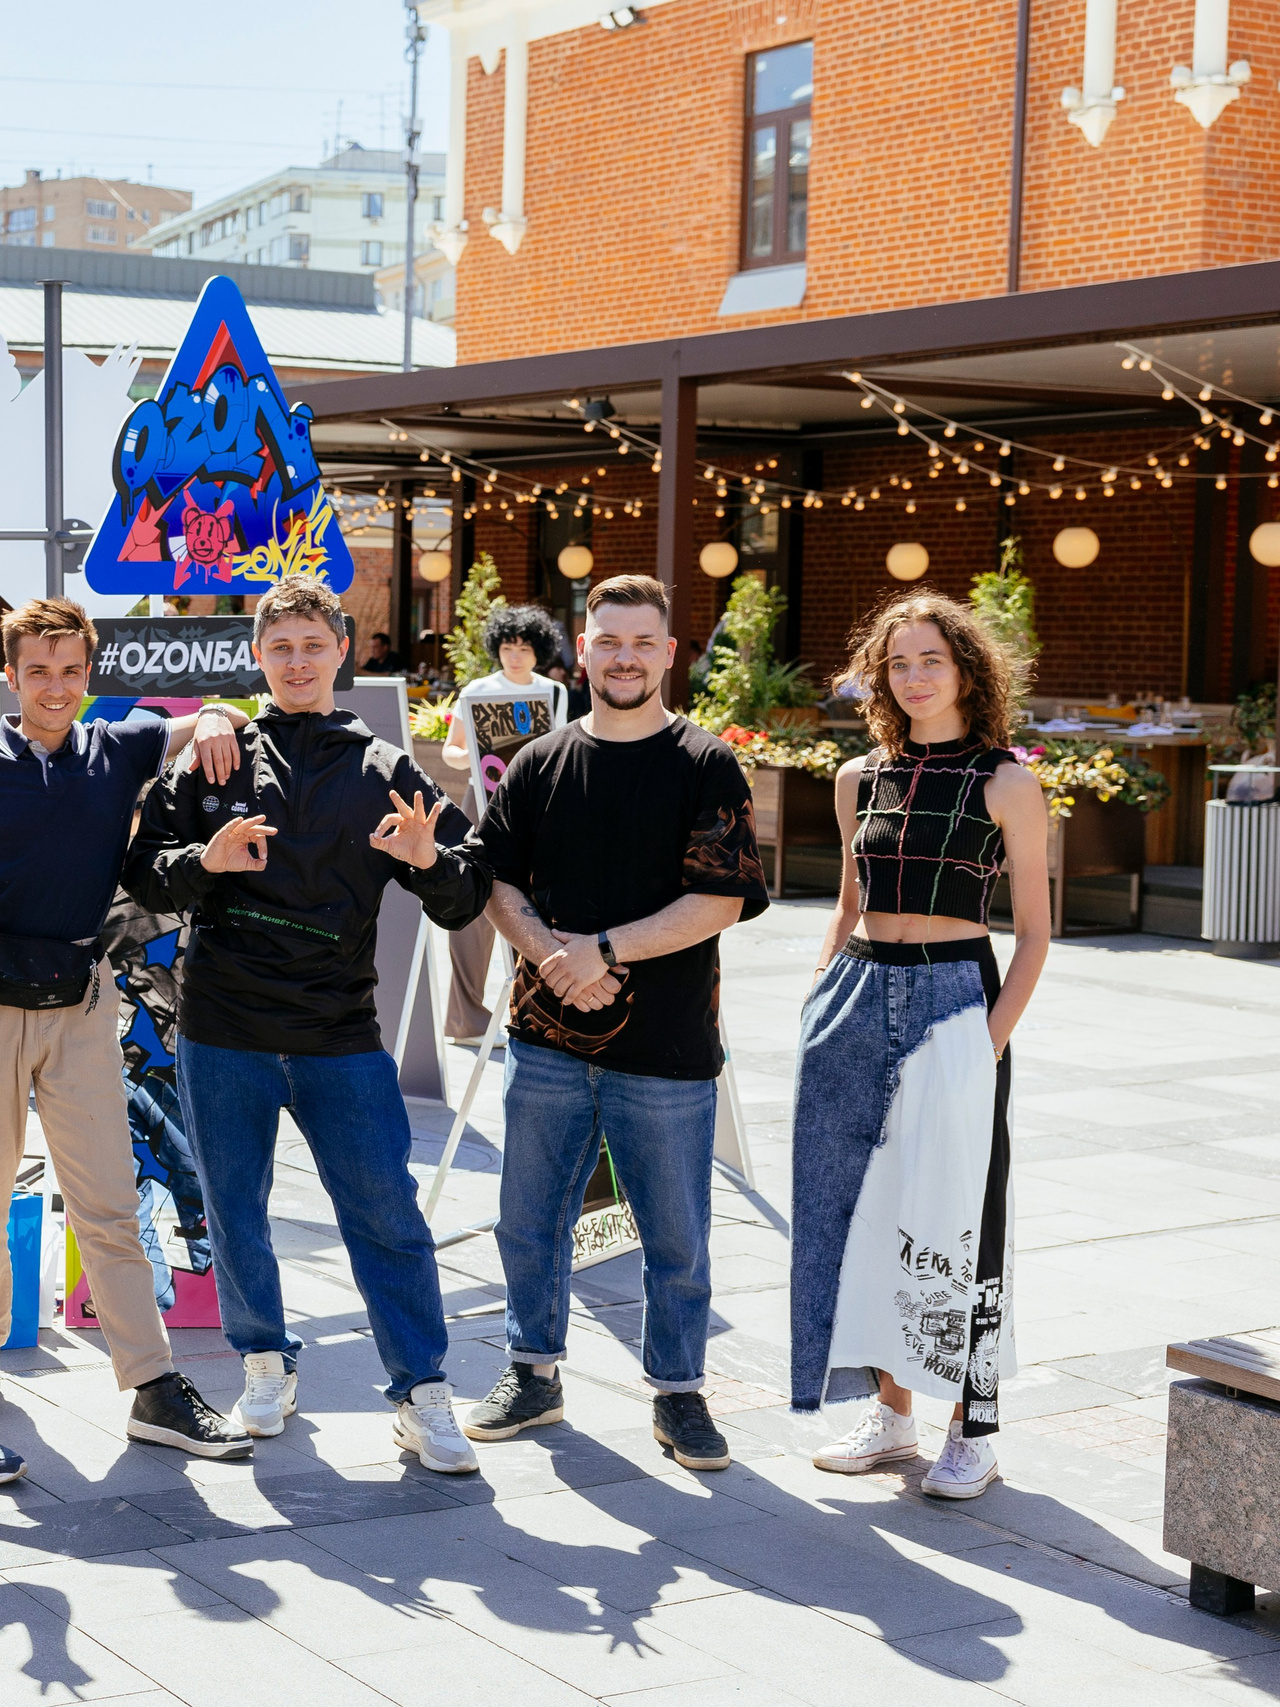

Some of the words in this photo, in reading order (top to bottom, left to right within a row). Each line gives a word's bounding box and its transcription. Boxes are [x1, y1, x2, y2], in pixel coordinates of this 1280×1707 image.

[97, 641, 261, 675] #OZONБА
[291, 922, 303, 930] НА
[305, 926, 340, 940] УЛИЦАХ
